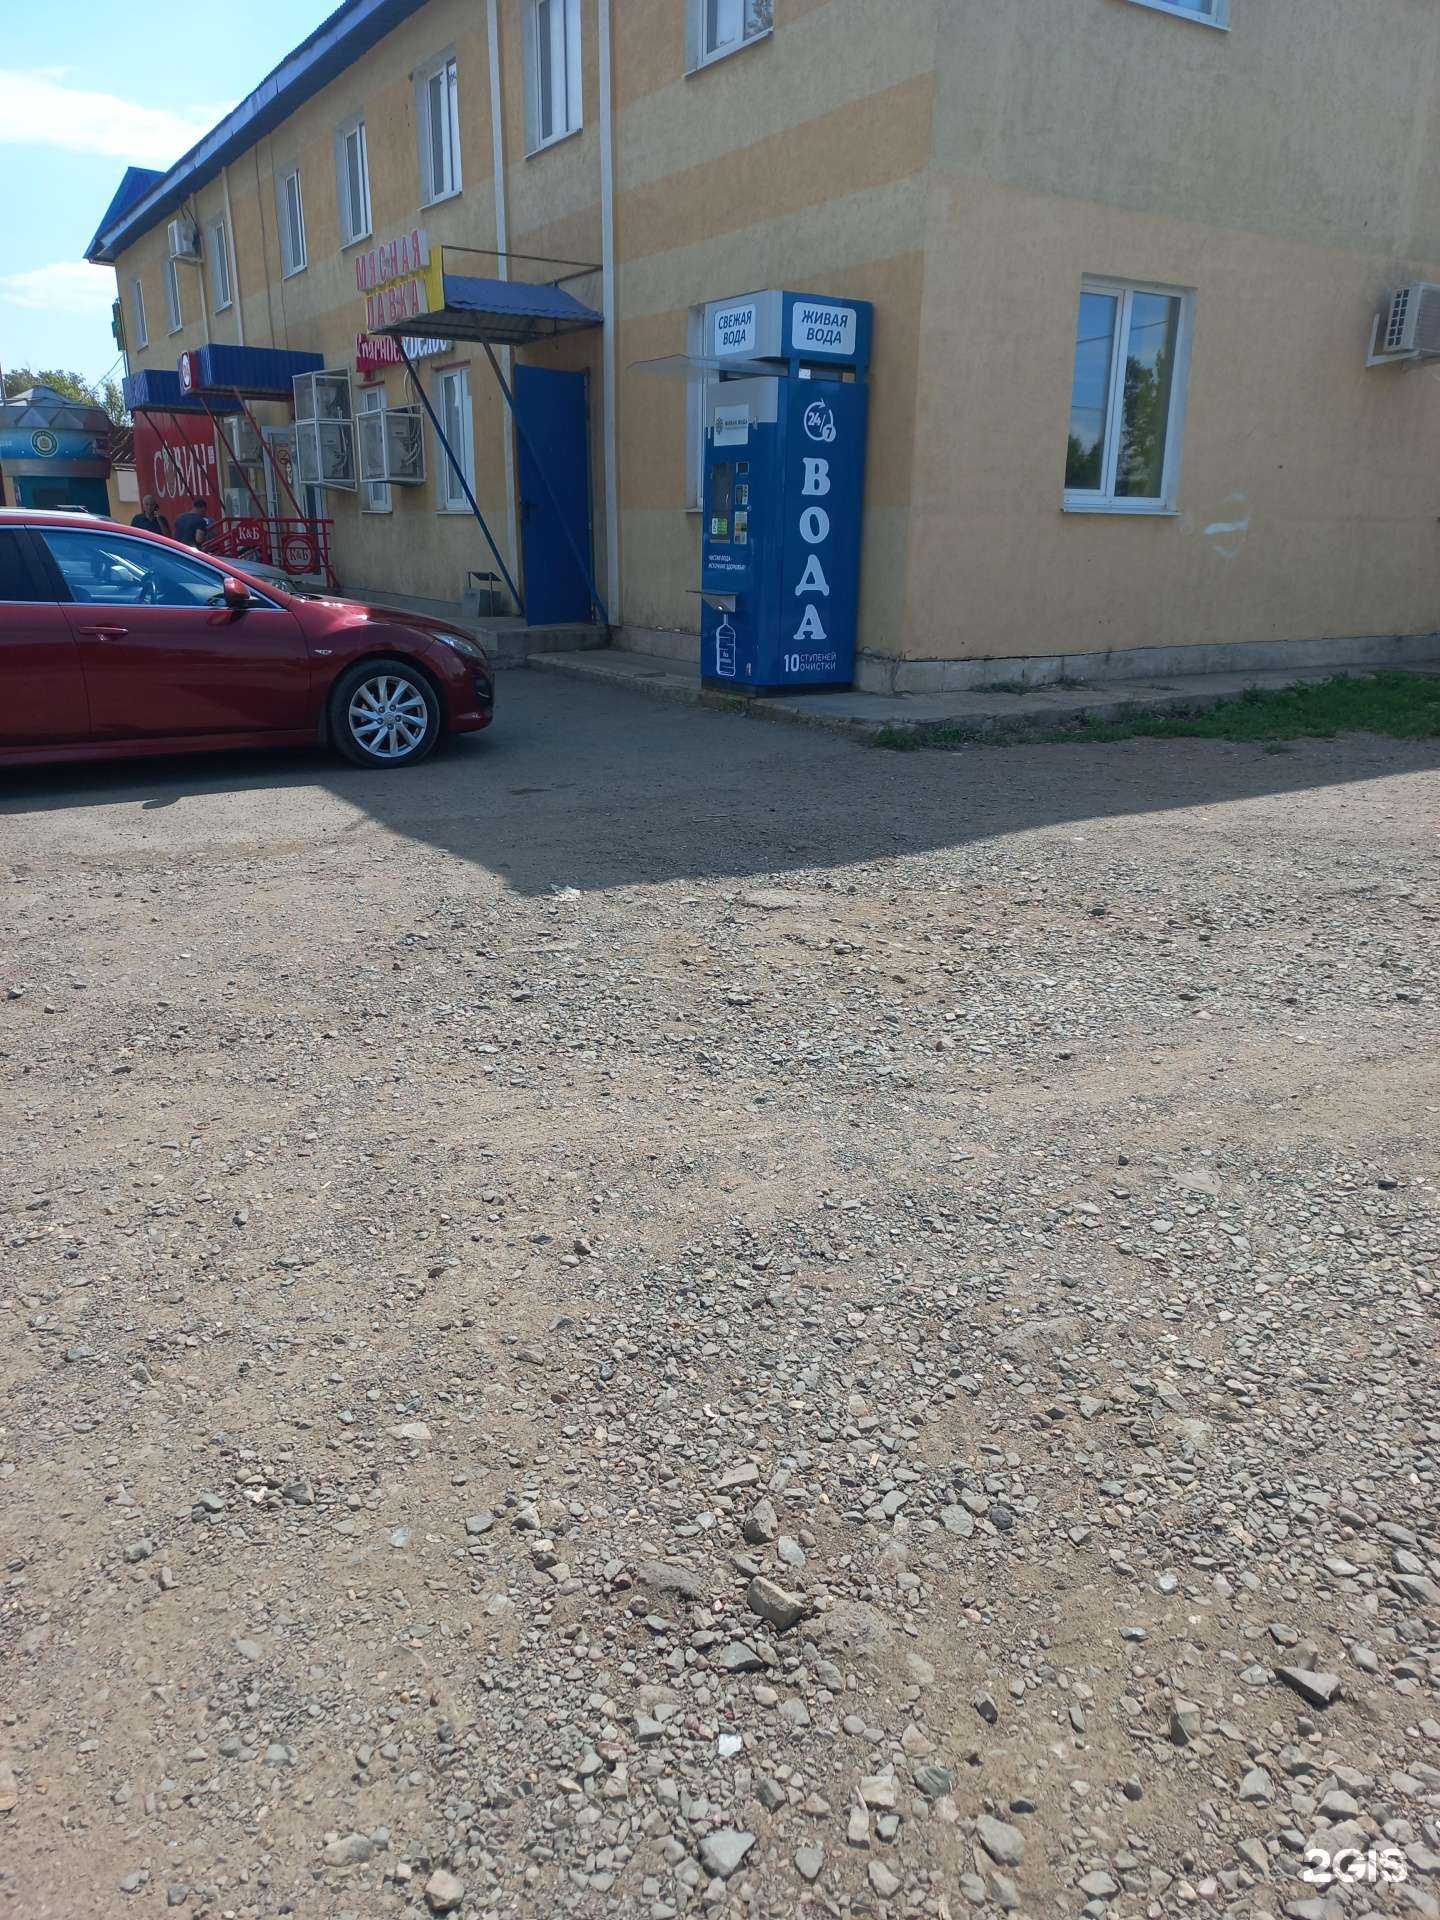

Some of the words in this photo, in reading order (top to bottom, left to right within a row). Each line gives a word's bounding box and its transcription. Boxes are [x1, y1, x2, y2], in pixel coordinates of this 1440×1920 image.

[355, 228, 421, 291] МЯСНАЯ
[367, 279, 421, 331] ЛАВКА
[718, 310, 752, 330] СВЕЖАЯ
[801, 309, 849, 328] ЖИВАЯ
[722, 329, 747, 346] ВОДА
[806, 327, 842, 346] ВОДА
[238, 526, 260, 541] К&Б
[792, 456, 831, 641] ВОДА
[783, 653, 800, 673] 10
[800, 651, 837, 663] СТУПЕНЕЙ
[799, 661, 837, 672] ОЧИСТКИ
